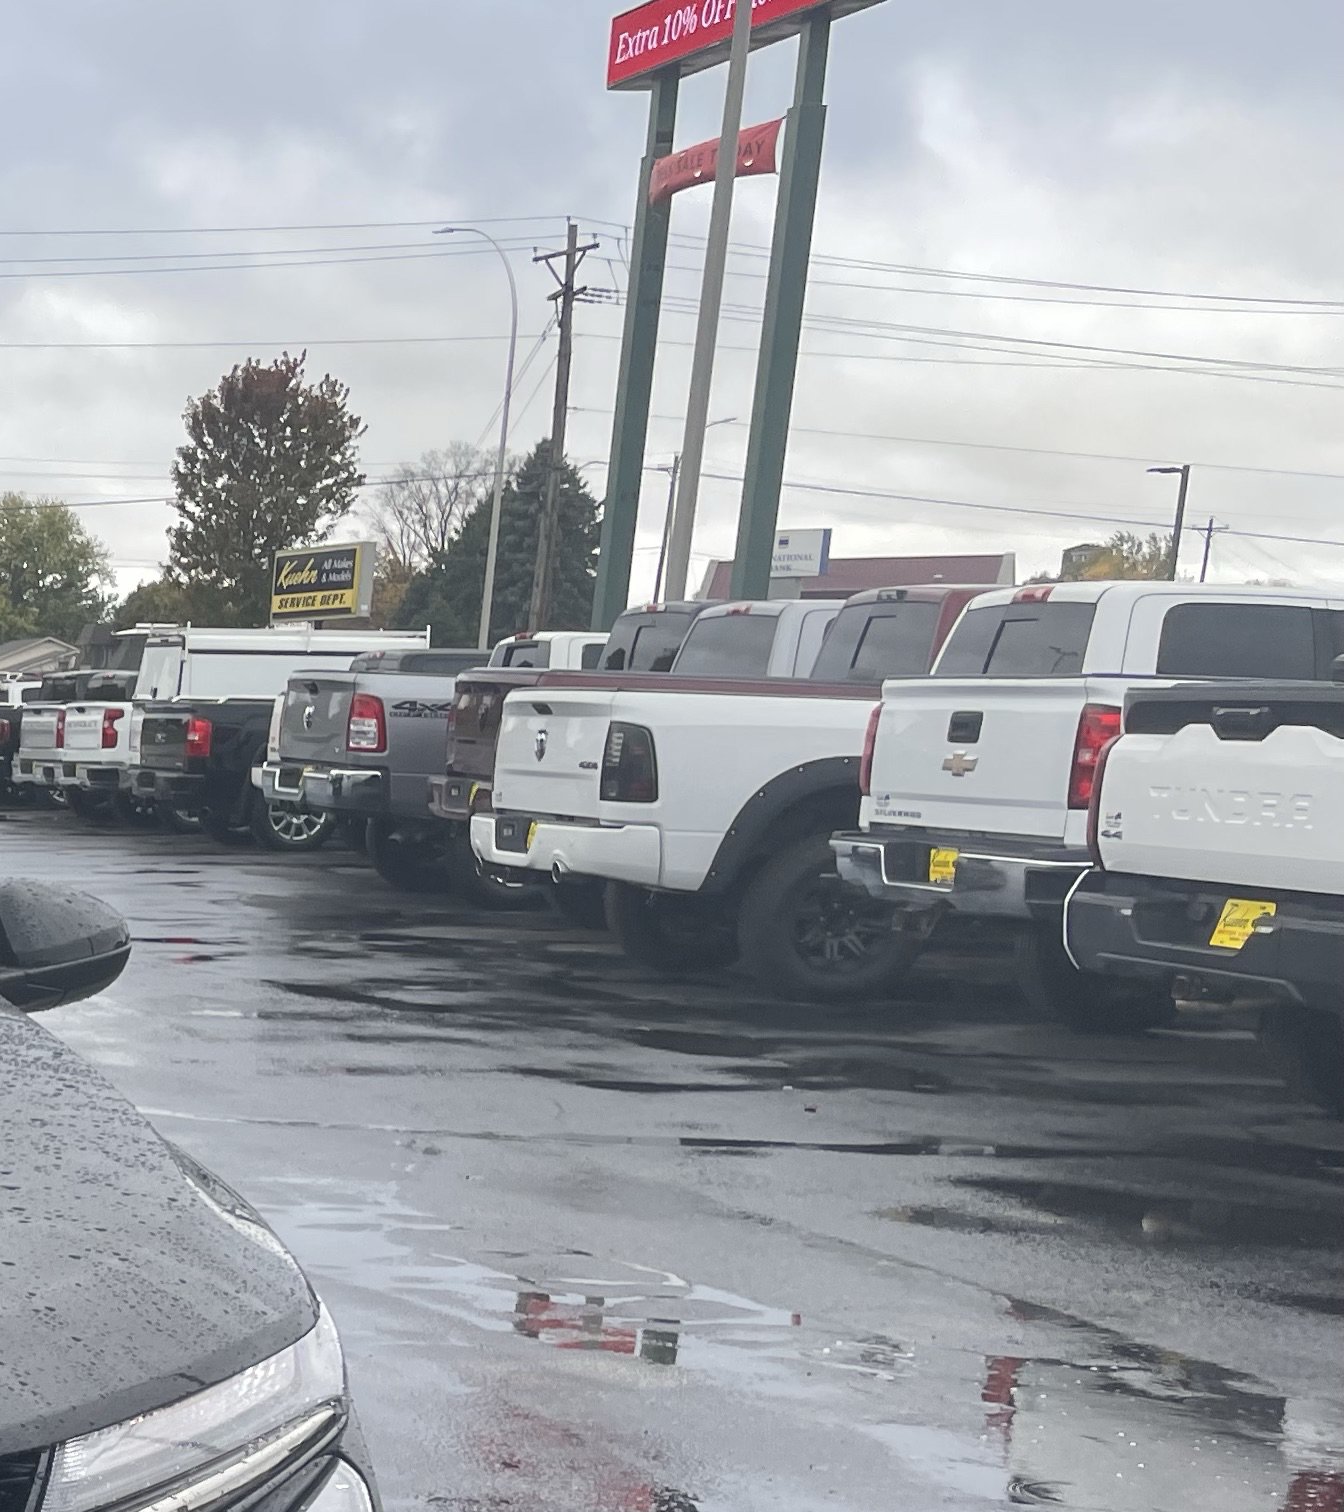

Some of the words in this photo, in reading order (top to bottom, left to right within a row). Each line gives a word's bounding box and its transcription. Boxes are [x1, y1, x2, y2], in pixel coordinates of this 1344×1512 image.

[614, 26, 659, 64] Extra
[662, 5, 698, 46] 10%
[277, 558, 318, 589] Kuehn
[278, 594, 317, 609] SERVICE
[1149, 786, 1313, 830] TUNDRA
